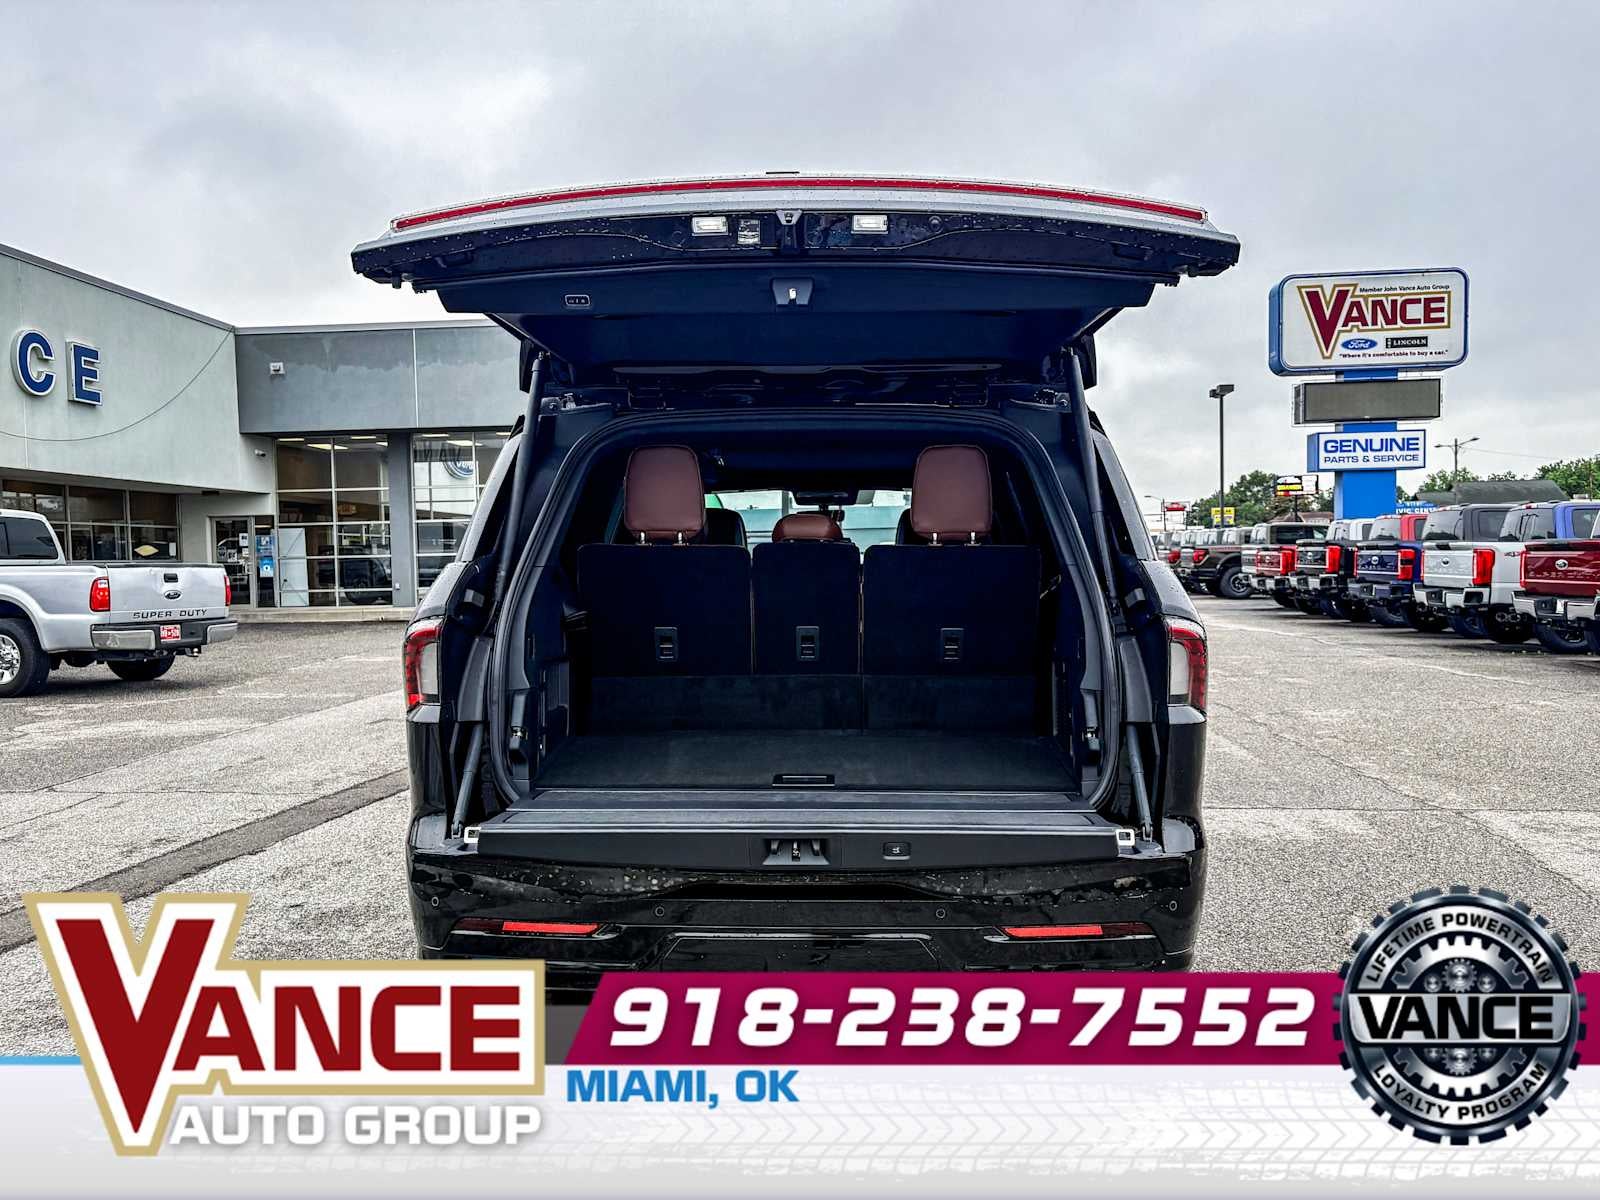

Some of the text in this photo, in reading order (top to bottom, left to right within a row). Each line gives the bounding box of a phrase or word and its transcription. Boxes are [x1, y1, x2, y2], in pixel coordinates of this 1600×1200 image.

[1304, 288, 1446, 354] VANCE
[1347, 339, 1371, 348] Ford
[1393, 338, 1427, 346] LINCOLN
[1323, 437, 1420, 453] GENUINE
[1324, 454, 1420, 464] PARTS & SERVICE
[133, 608, 207, 620] SUPER DUTY
